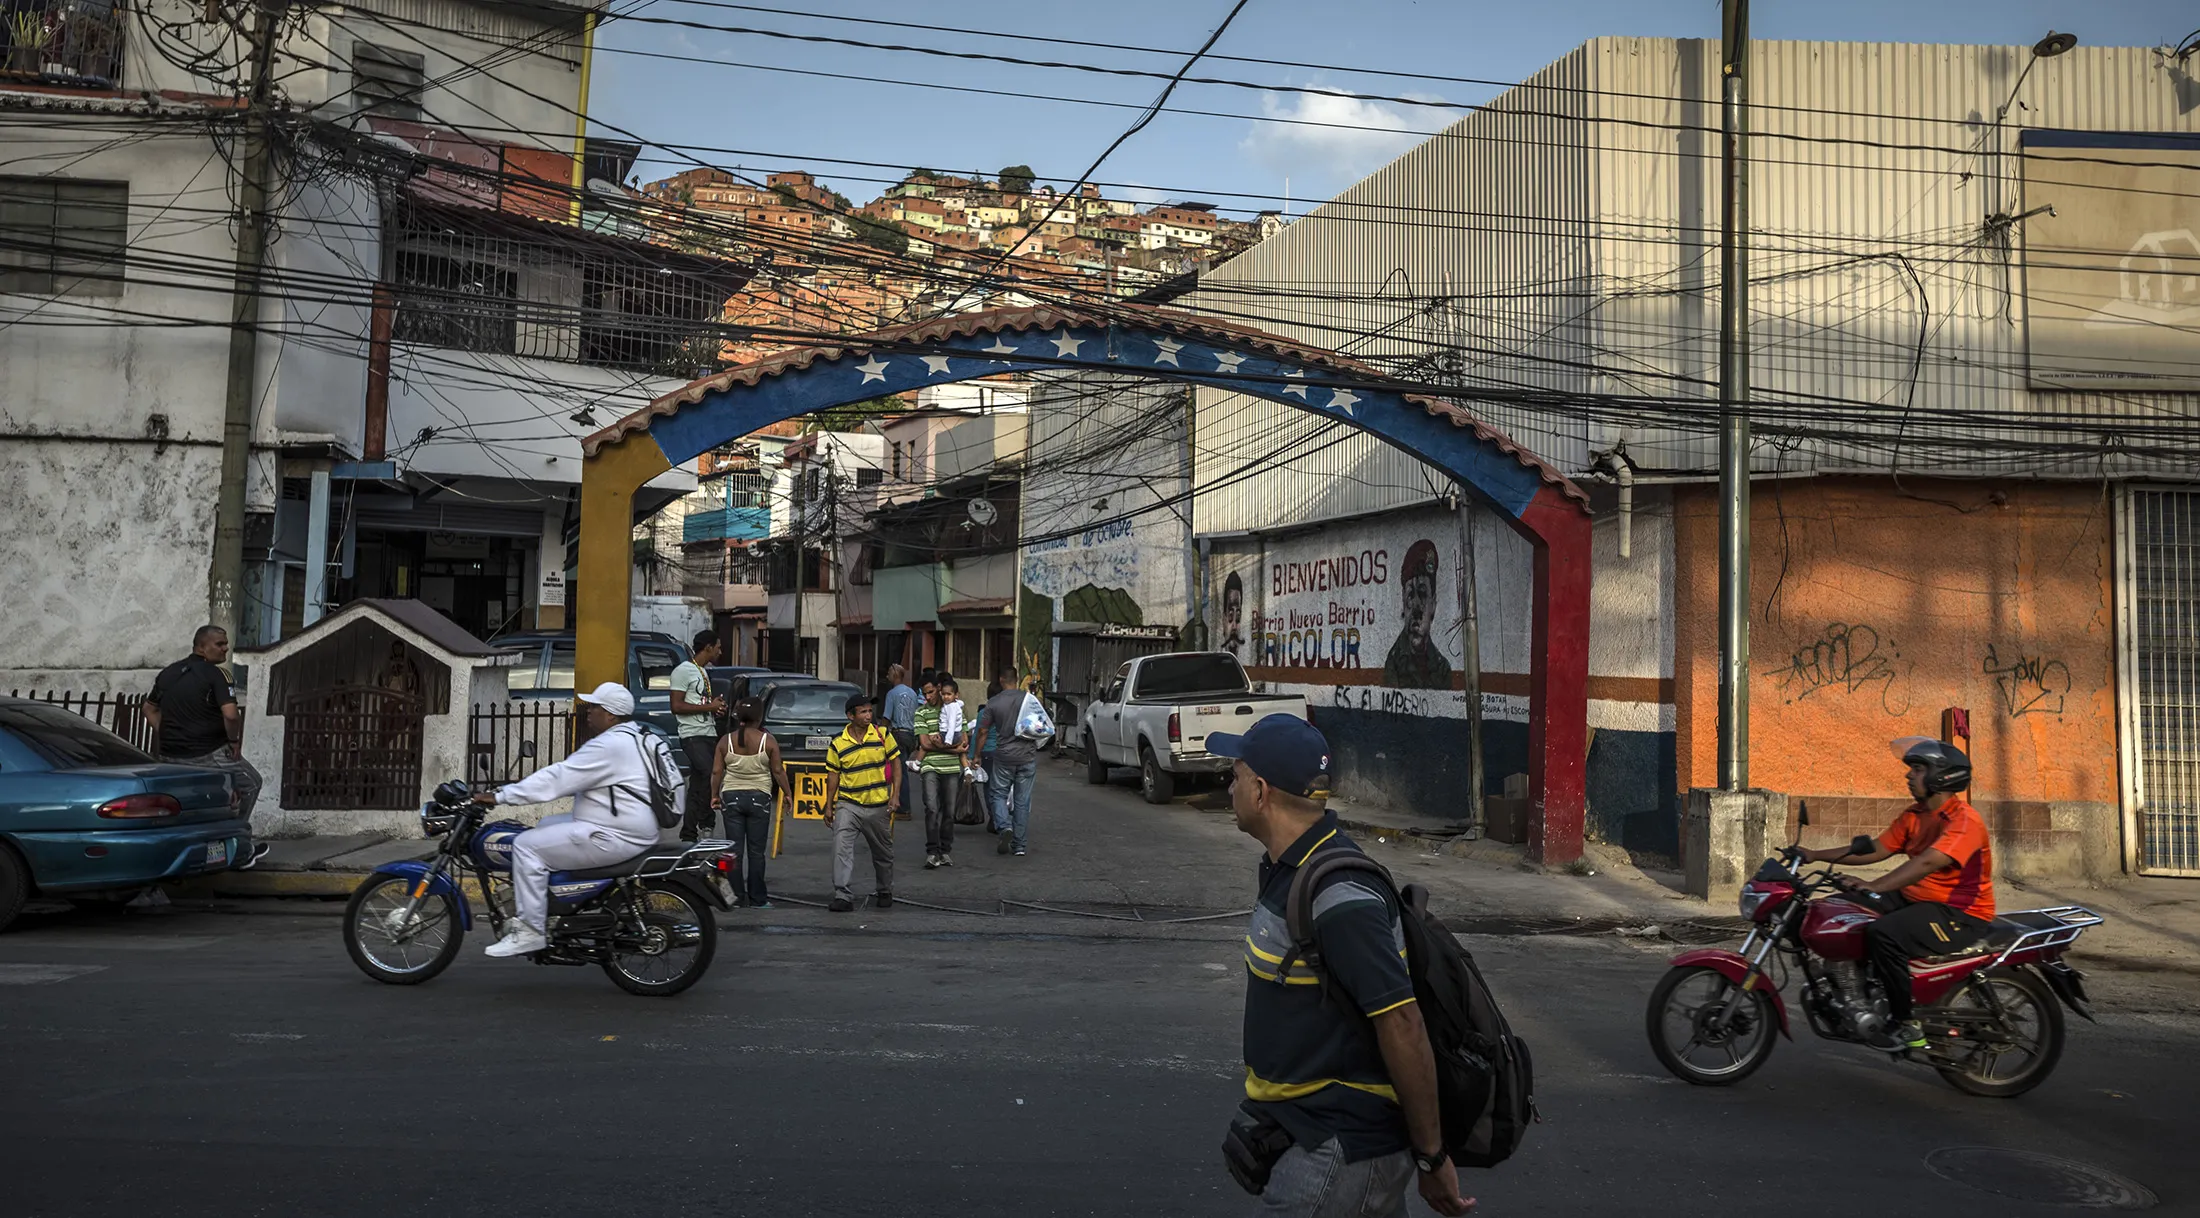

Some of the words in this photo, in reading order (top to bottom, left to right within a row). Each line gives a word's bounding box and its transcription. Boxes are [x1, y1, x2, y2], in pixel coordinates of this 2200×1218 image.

[1273, 550, 1387, 596] BIENVENIDOS
[1251, 610, 1285, 631] Barrio
[1289, 608, 1323, 630] Nuevo
[1328, 600, 1375, 626] Barrio
[1251, 628, 1361, 669] TRICOLOR
[1335, 685, 1351, 709] ES
[1481, 704, 1501, 714] ASURA
[803, 777, 828, 796] EN
